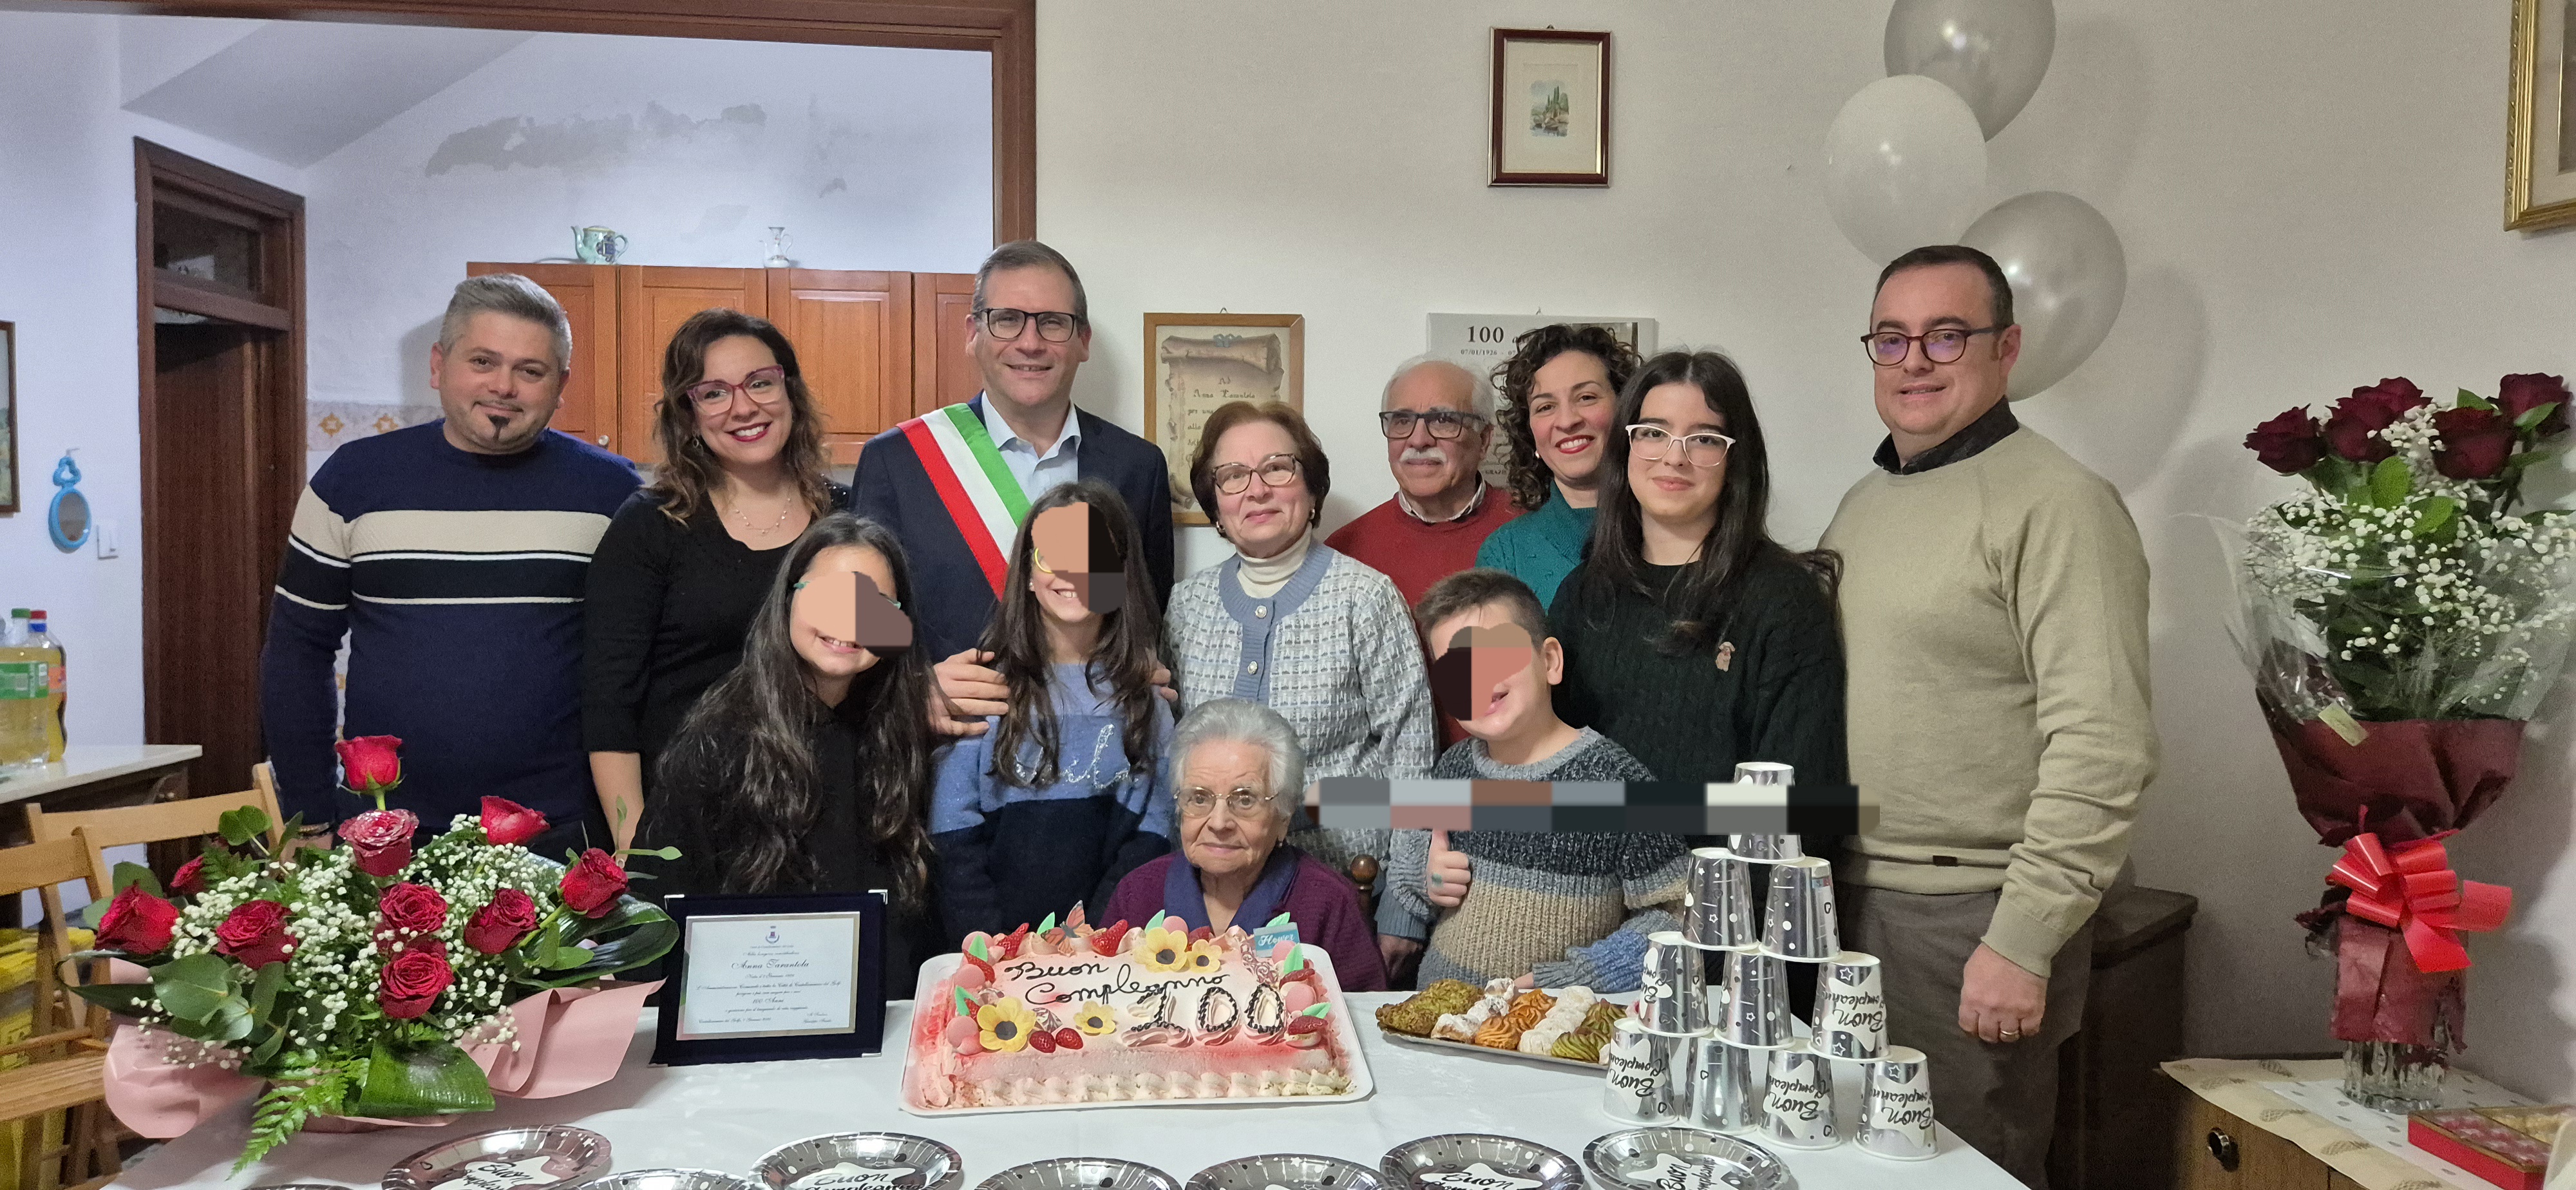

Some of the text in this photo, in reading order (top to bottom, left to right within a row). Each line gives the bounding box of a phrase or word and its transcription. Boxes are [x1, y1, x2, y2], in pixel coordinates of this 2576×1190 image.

[1468, 326, 1504, 343] 100
[1258, 933, 1295, 946] Flower
[732, 959, 810, 970] Anna Tarantola
[1004, 960, 1110, 981] Buon
[1025, 963, 1230, 1005] Compleanno
[1127, 982, 1285, 1035] 100
[1832, 1009, 1884, 1033] Buon
[1609, 1068, 1654, 1097] Buon
[1768, 1091, 1819, 1121] Buon
[1880, 1107, 1932, 1130] Buon
[478, 1162, 535, 1185] Buon
[814, 1173, 892, 1185] Buon
[1441, 1171, 1515, 1190] Buon
